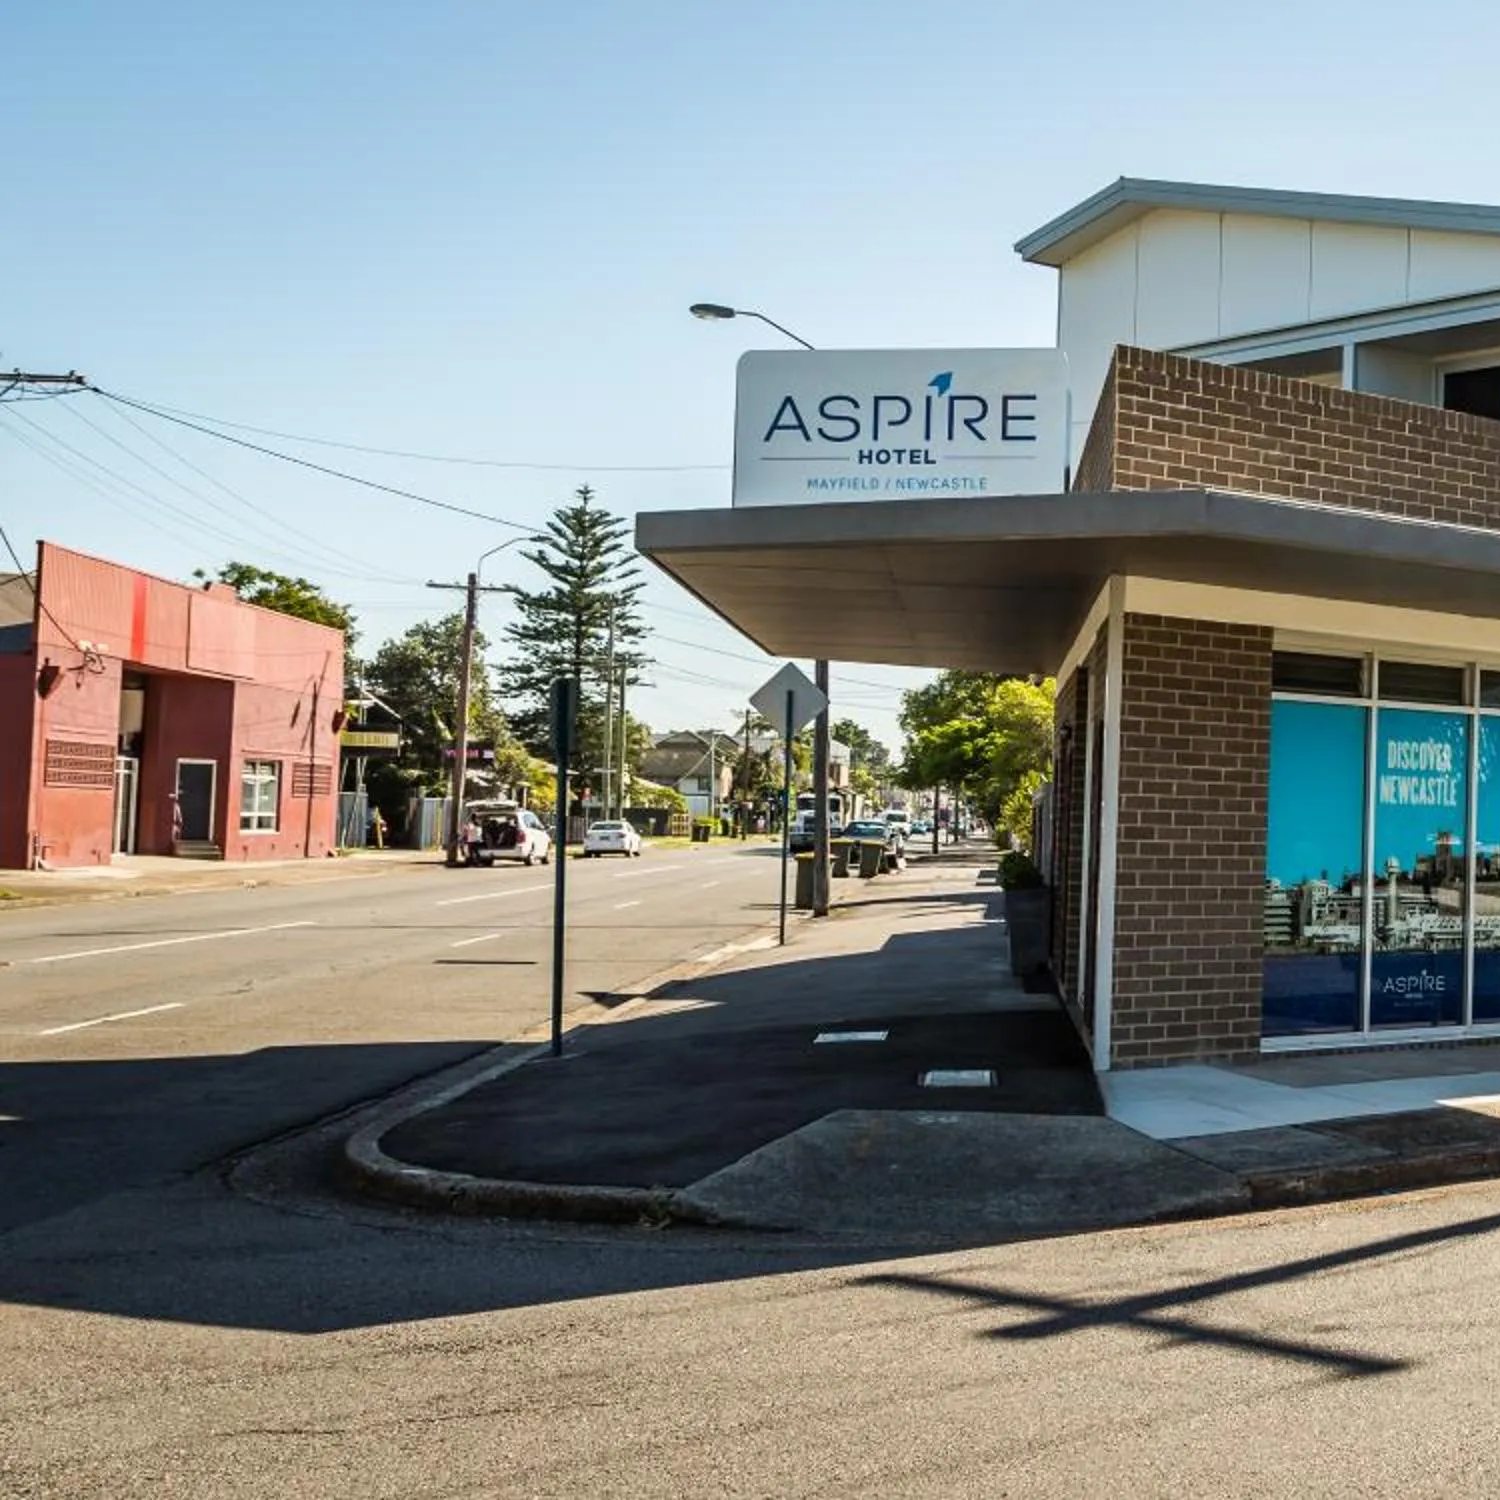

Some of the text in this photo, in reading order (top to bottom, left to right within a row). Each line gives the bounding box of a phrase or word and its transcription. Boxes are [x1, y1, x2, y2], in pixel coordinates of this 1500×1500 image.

[763, 393, 1038, 443] ASPIRE
[858, 448, 937, 465] HOTEL
[806, 476, 880, 491] MAYFIELD
[895, 476, 988, 491] NEWCASTLE
[1387, 741, 1452, 771] DISCOVER
[1380, 775, 1457, 806] NEWCASTLE
[1383, 975, 1446, 993] ASPIRE
